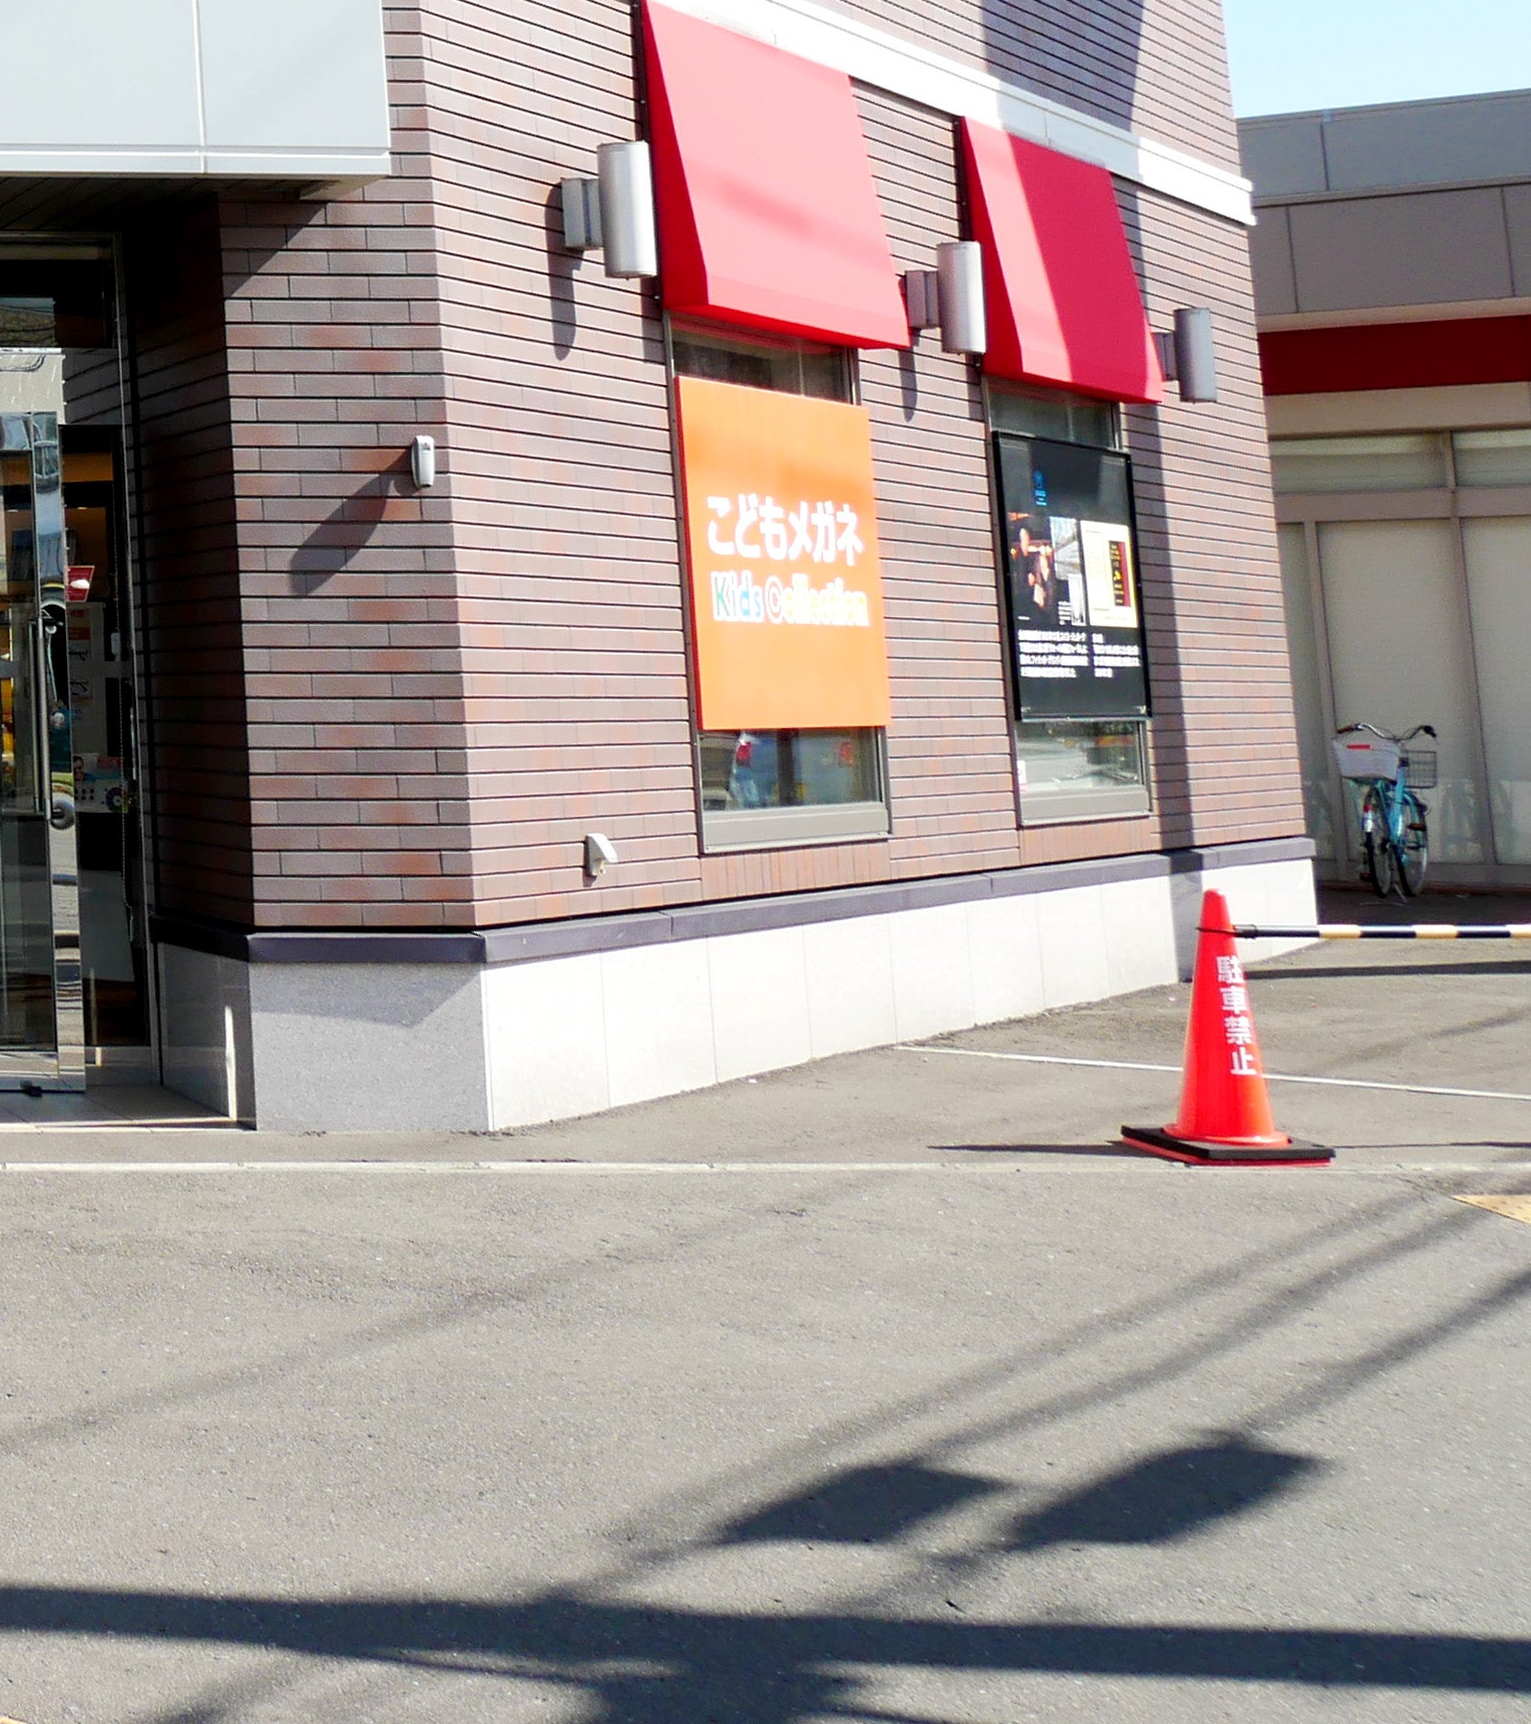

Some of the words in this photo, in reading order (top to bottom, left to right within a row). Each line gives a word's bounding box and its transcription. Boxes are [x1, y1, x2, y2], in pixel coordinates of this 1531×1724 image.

[706, 492, 865, 567] こどもメガネ
[710, 570, 765, 623] Kids
